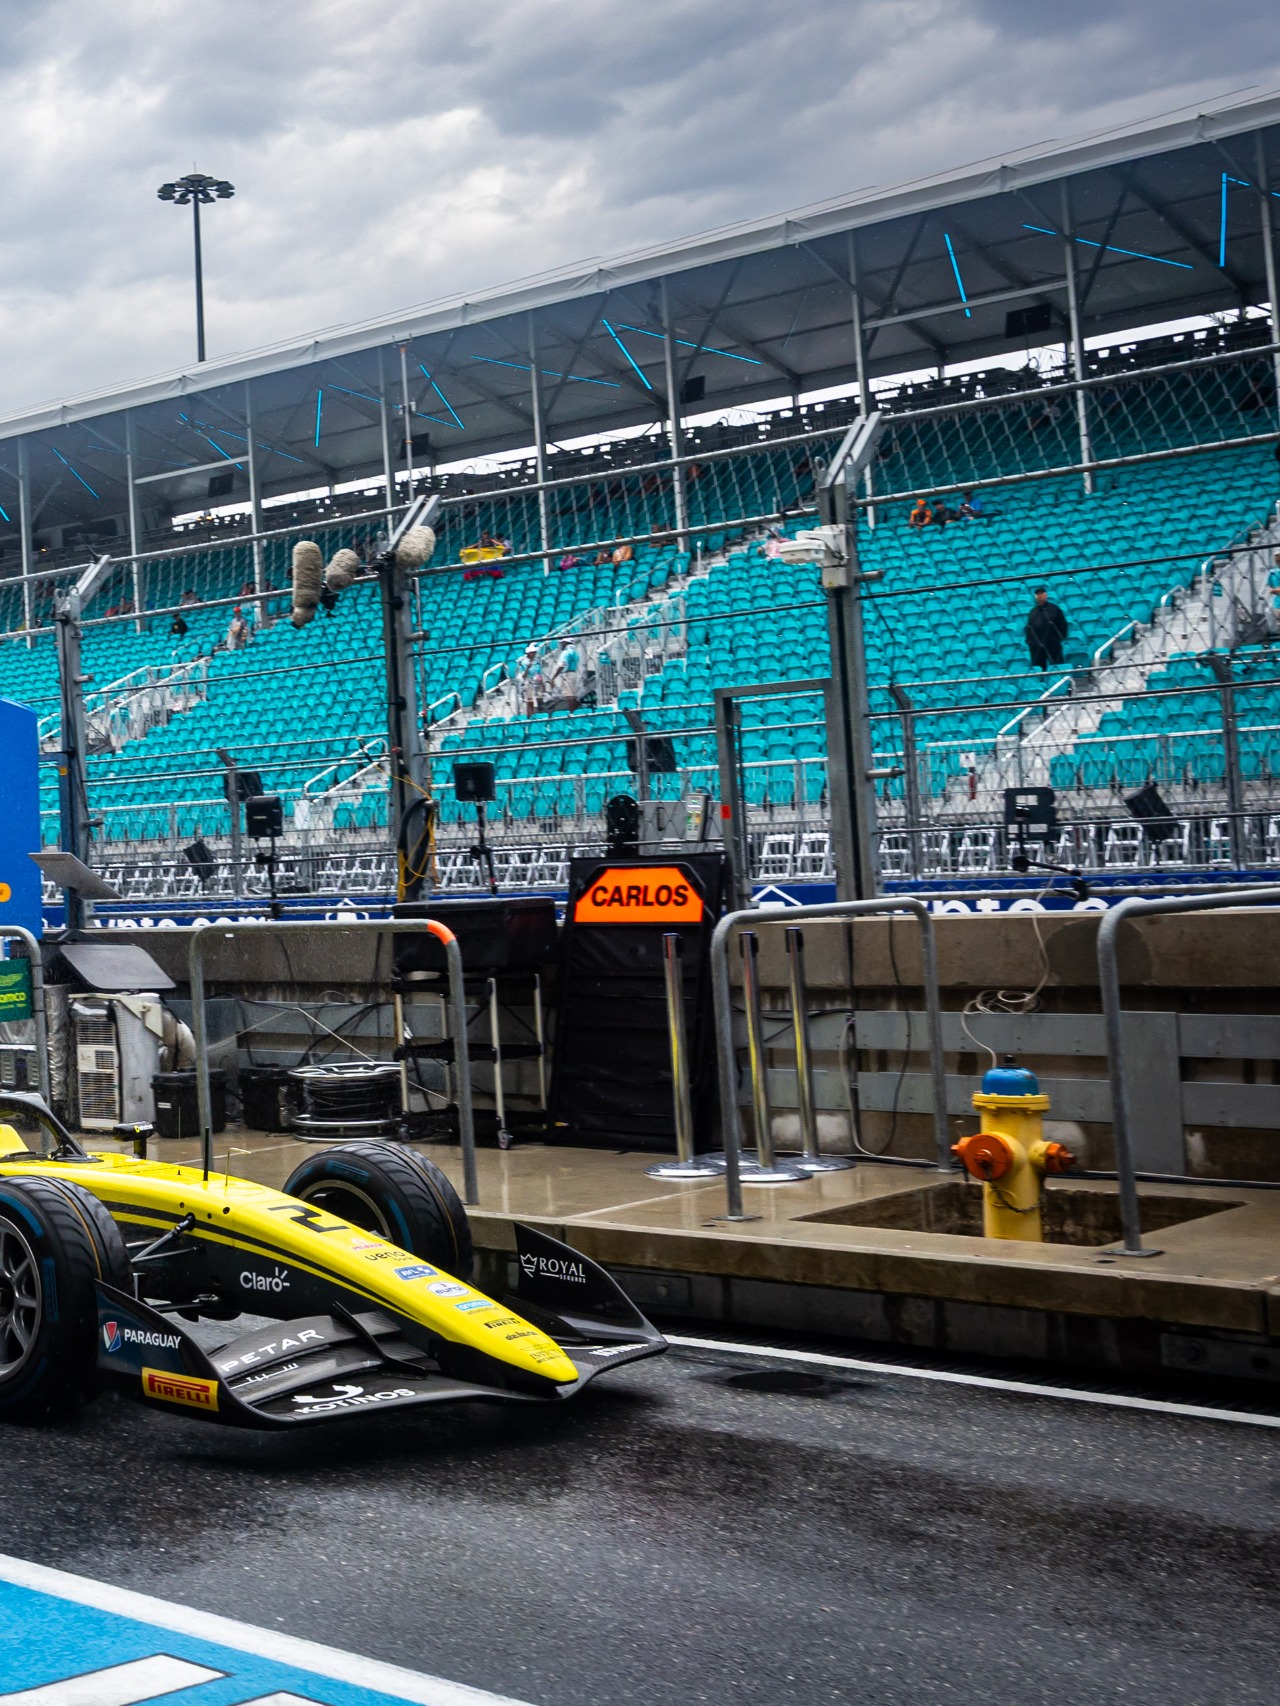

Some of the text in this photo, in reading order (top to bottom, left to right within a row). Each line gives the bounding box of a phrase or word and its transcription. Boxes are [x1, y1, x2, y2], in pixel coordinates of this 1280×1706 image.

[591, 883, 689, 909] CARLOS
[267, 1205, 350, 1233] 2
[540, 1257, 586, 1277] ROYAL
[240, 1270, 283, 1292] Claro
[125, 1329, 182, 1349] PARAGUAY
[148, 1373, 211, 1404] PIRELLI
[293, 1388, 417, 1414] KOTINOS
